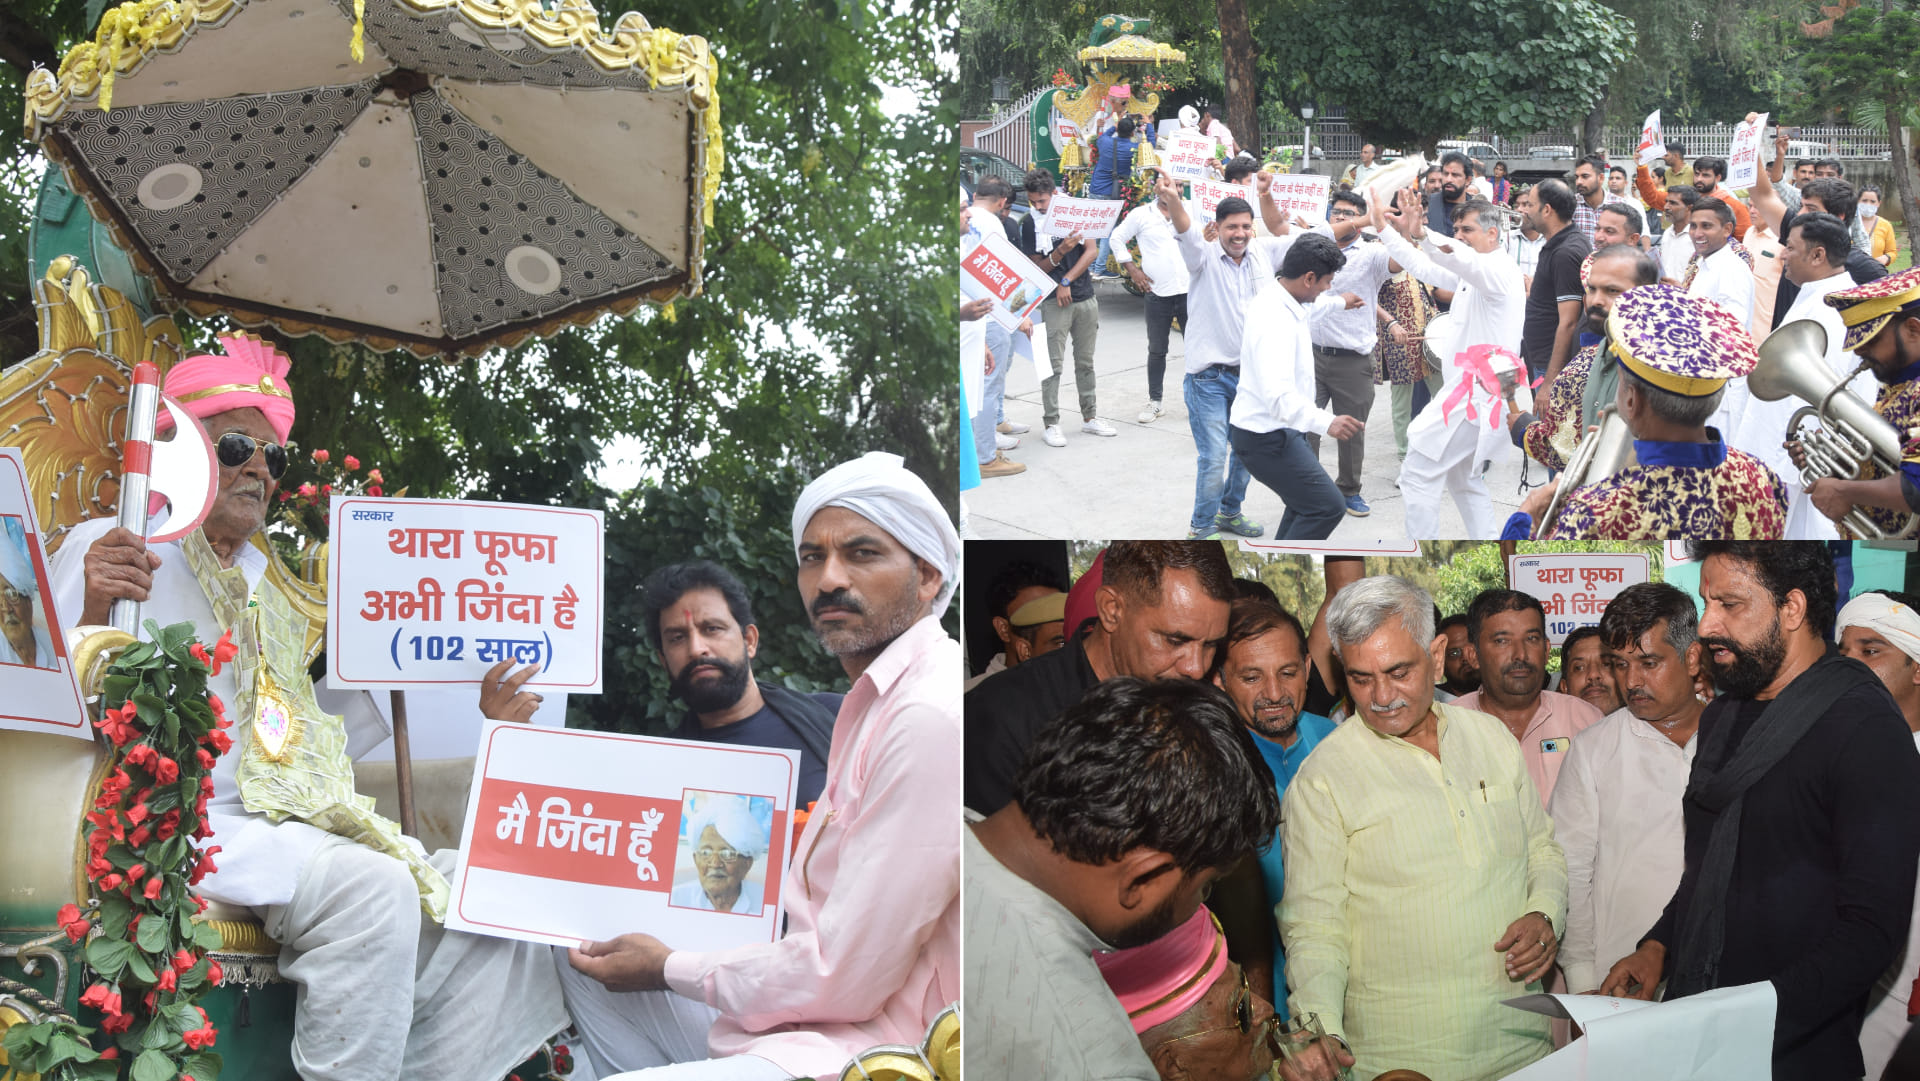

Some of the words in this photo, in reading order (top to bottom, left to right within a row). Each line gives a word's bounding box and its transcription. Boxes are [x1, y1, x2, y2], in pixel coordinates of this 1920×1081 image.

[982, 259, 1007, 285] जिंदा
[999, 277, 1018, 297] हूँ
[352, 510, 394, 522] सरकार
[388, 528, 464, 558] थारा
[474, 530, 558, 576] फूफा
[1537, 568, 1574, 584] थारा
[1579, 568, 1624, 591] फूफा
[360, 577, 445, 622] अभी
[455, 578, 544, 625] जिंदा
[553, 583, 580, 630] है
[1539, 592, 1566, 615] भी
[496, 791, 530, 845] मै
[537, 796, 621, 856] जिंदा
[628, 807, 664, 881] हूँ
